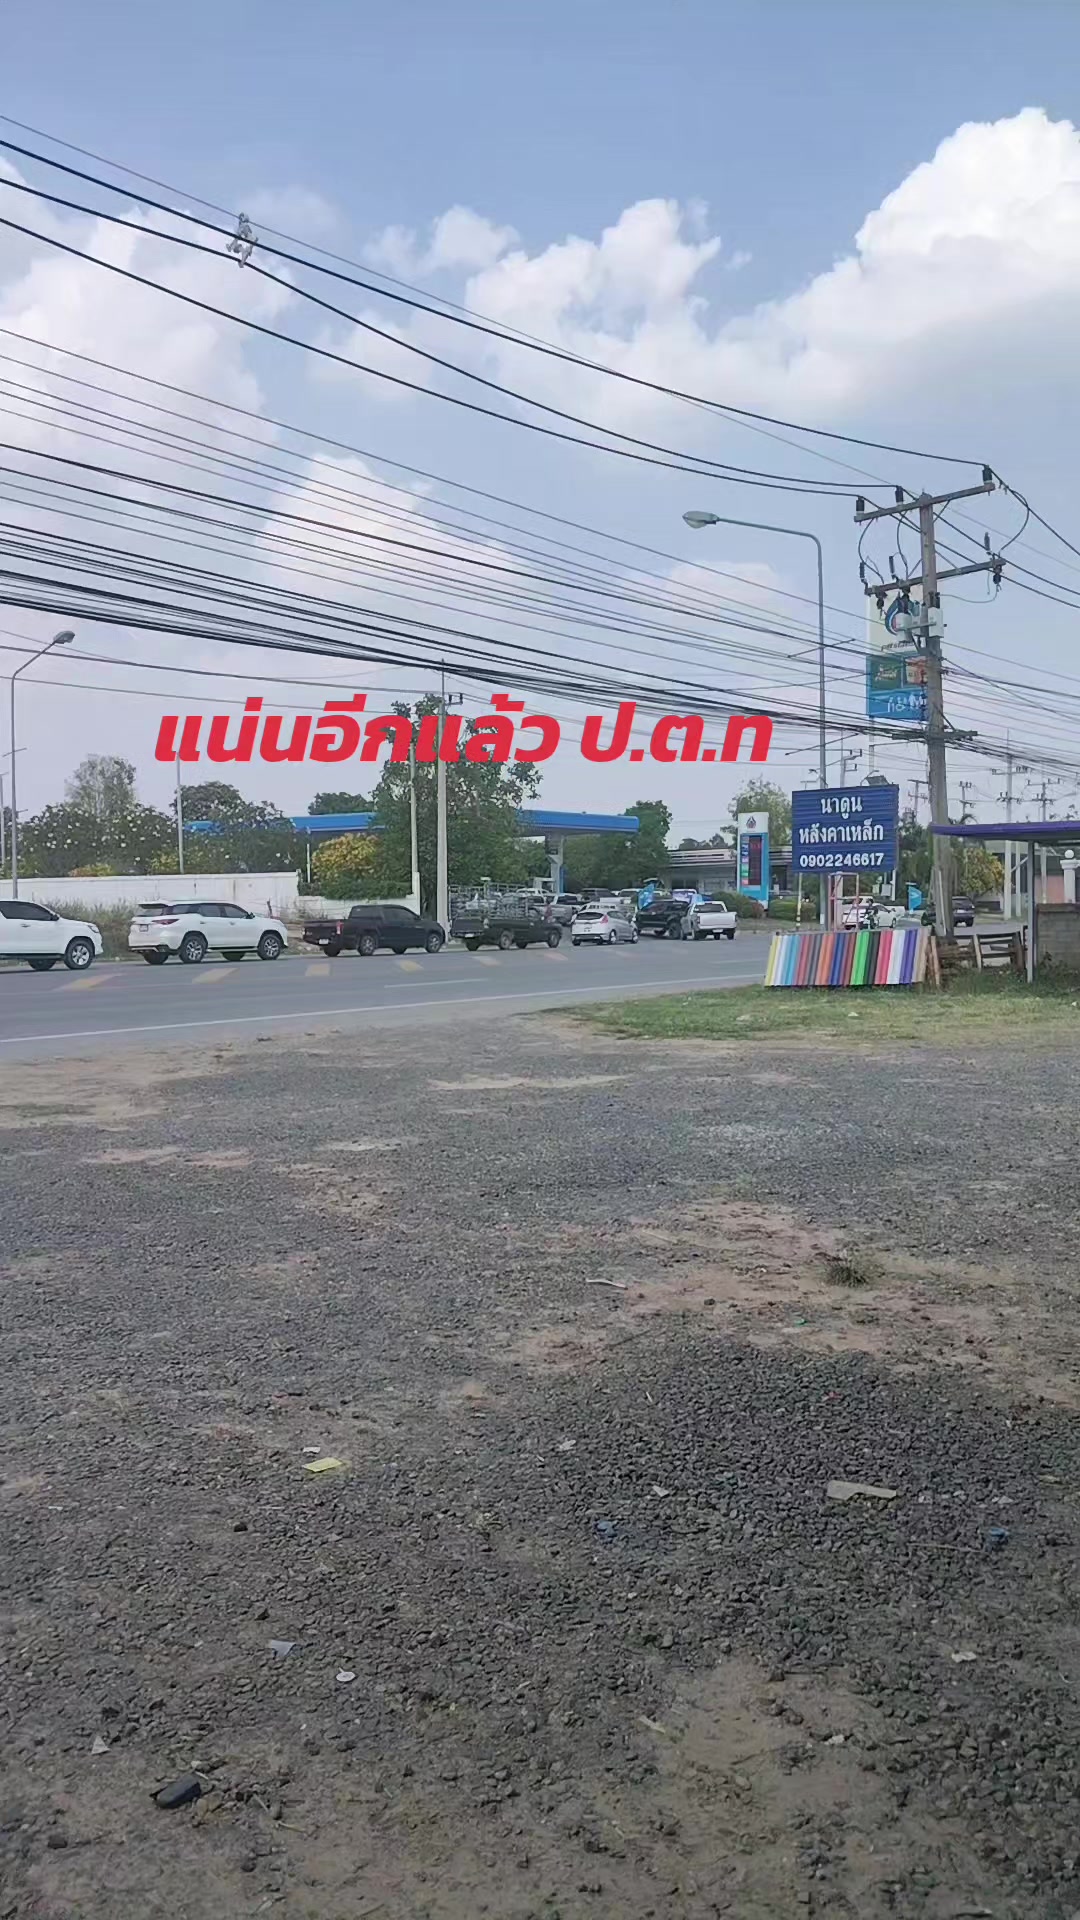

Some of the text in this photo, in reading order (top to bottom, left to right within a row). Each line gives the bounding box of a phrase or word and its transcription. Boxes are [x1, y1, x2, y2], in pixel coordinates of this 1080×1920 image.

[820, 795, 863, 819] นาดูน
[799, 818, 884, 844] หลังคาเหล็ก
[799, 853, 884, 867] 0902246617
